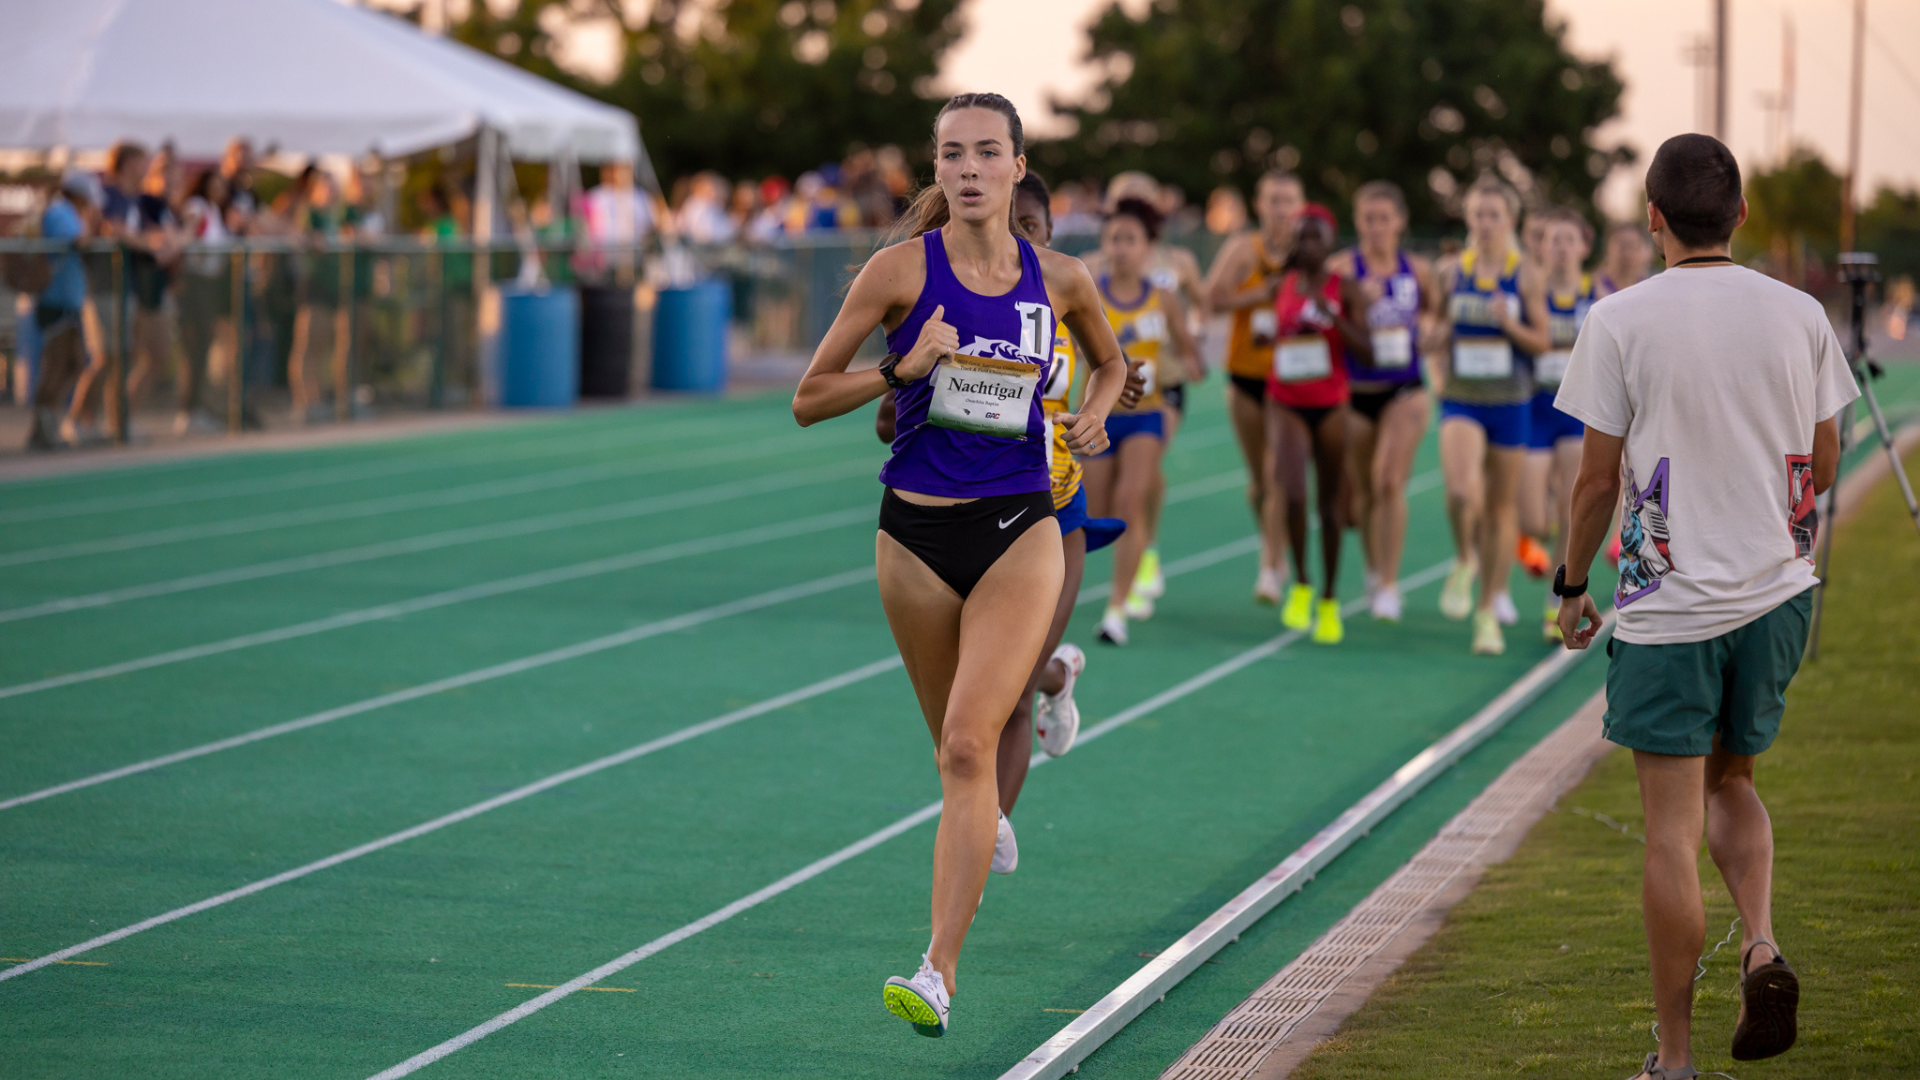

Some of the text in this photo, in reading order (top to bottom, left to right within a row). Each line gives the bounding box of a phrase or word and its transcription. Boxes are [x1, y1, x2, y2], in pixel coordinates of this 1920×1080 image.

[1027, 307, 1042, 355] 1
[989, 369, 1021, 378] Championships
[1003, 365, 1026, 373] Conference
[947, 377, 1023, 401] Nachtigal
[985, 412, 1000, 420] GAC
